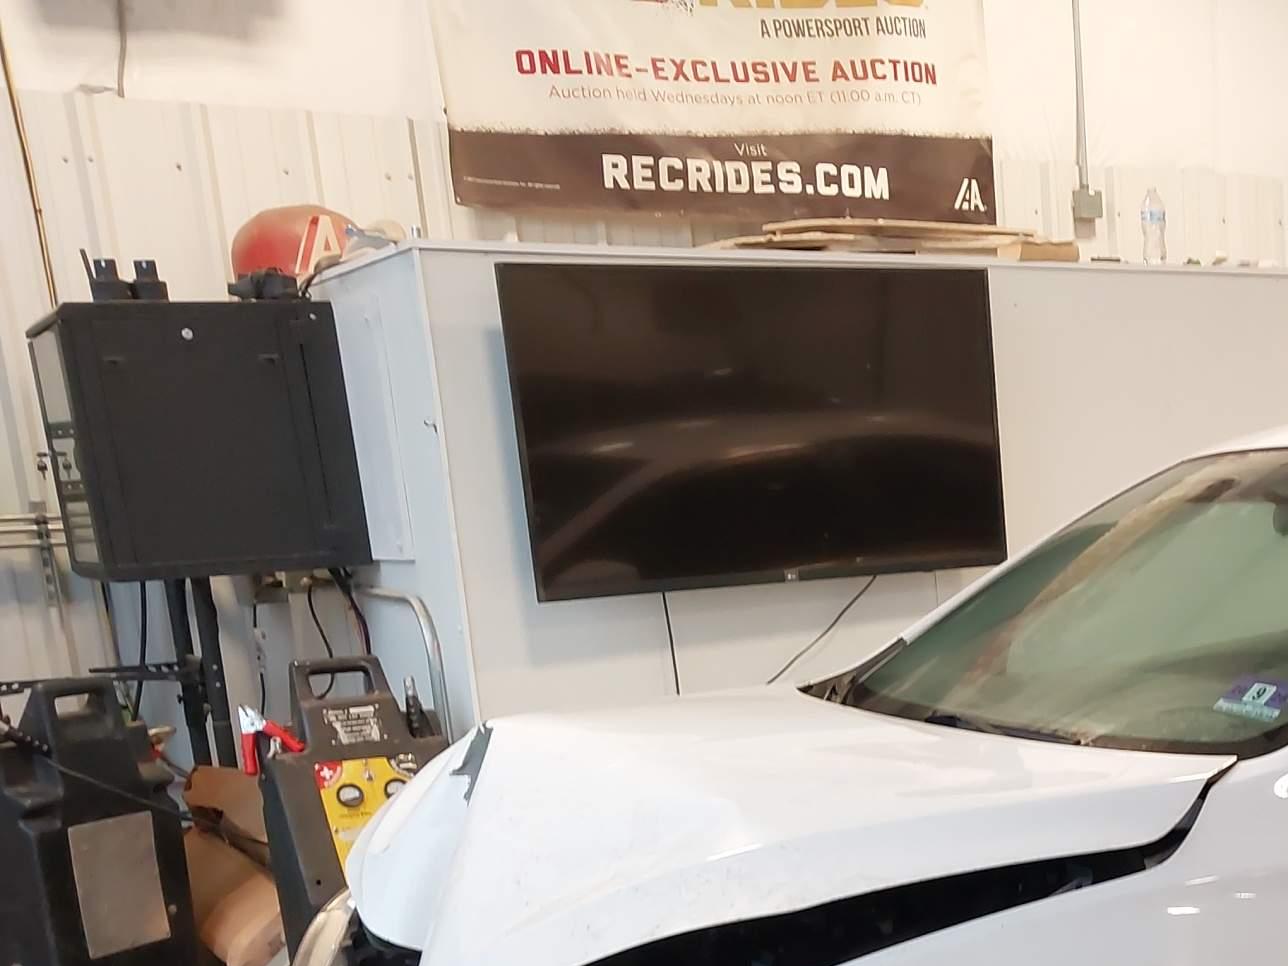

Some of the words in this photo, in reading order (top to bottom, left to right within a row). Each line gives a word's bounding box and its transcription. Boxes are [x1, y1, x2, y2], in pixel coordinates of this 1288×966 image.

[761, 19, 771, 38] A
[773, 16, 870, 38] POWERSPORT
[875, 16, 926, 39] AUCTION
[515, 48, 819, 83] ONLINE-EXCLUSIVE
[832, 59, 936, 84] AUCTION
[550, 85, 611, 99] Auction
[650, 90, 743, 106] Wednesdays
[735, 142, 767, 158] Visit
[602, 153, 890, 201] RECRIDES.COM
